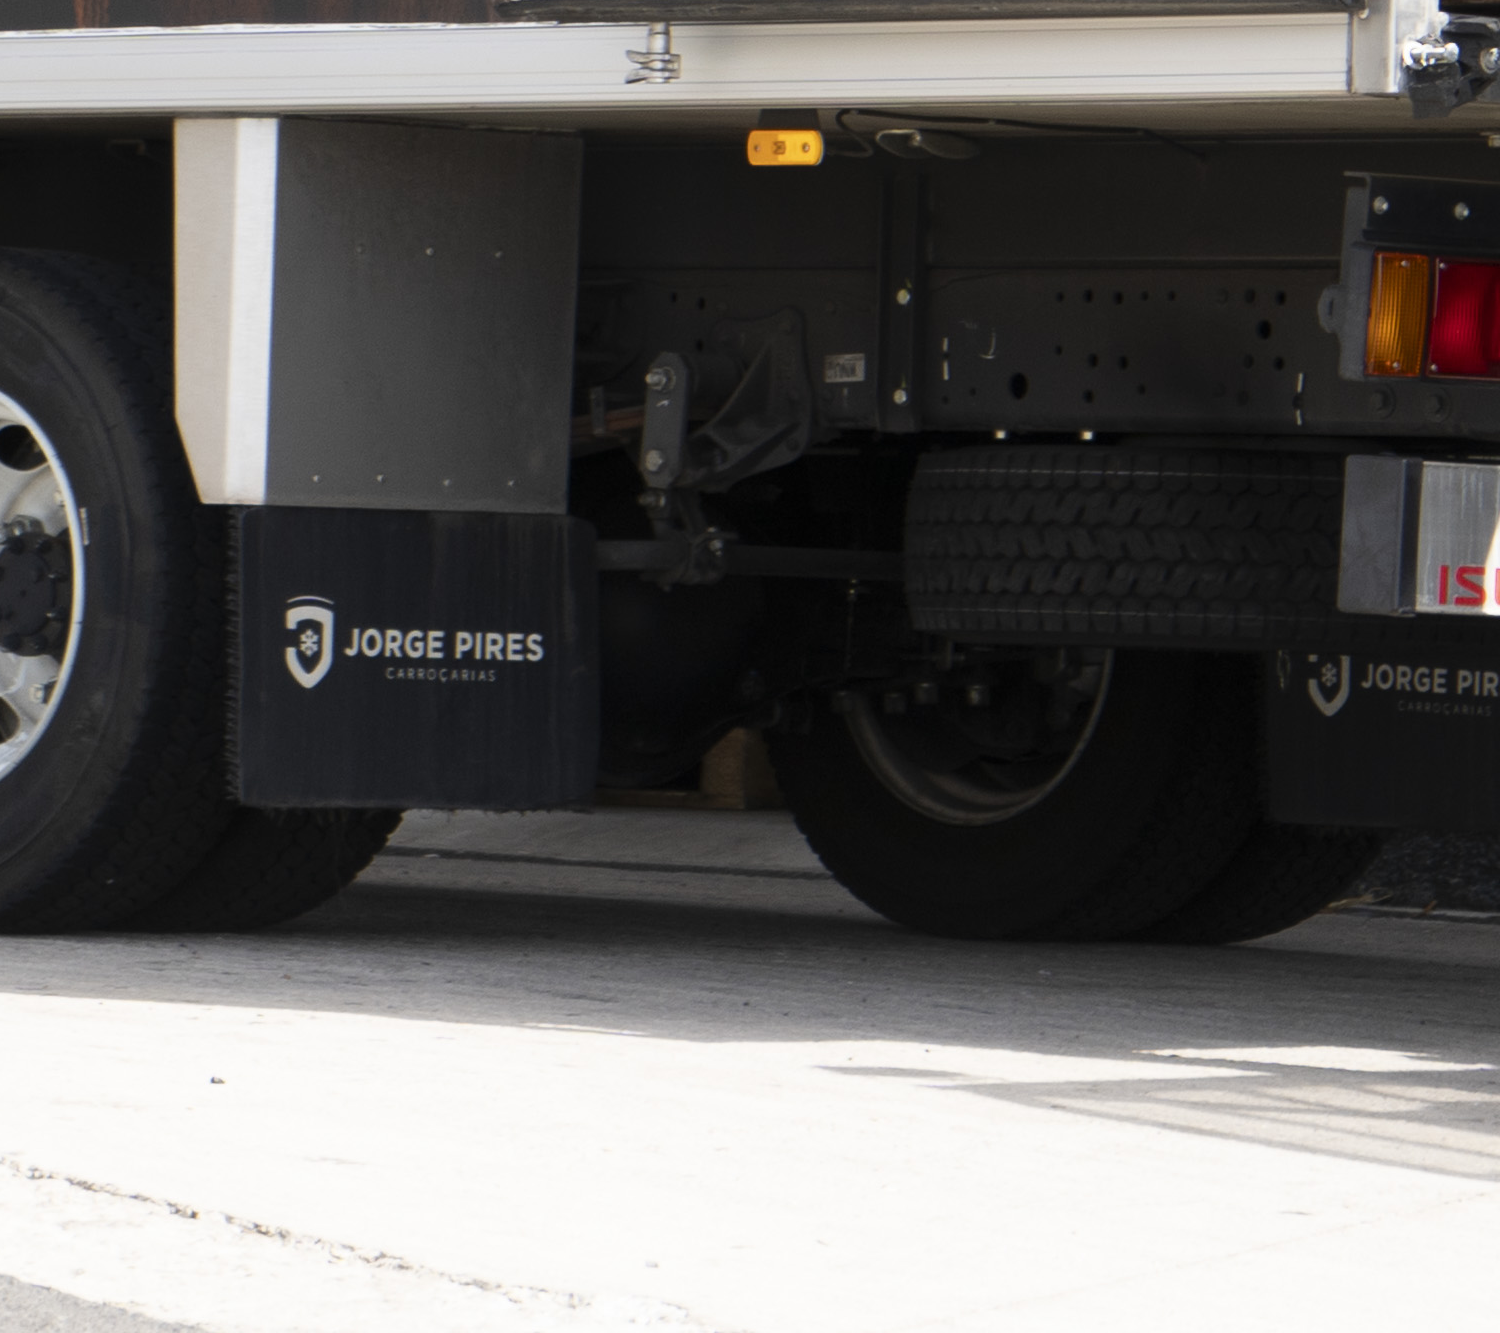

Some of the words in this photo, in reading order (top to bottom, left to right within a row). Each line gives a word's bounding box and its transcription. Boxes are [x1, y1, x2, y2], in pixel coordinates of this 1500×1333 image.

[344, 627, 445, 660] JORGE
[454, 632, 545, 663] PIRES
[385, 666, 497, 684] CARROÇARIAS
[1360, 663, 1448, 694] JORGE
